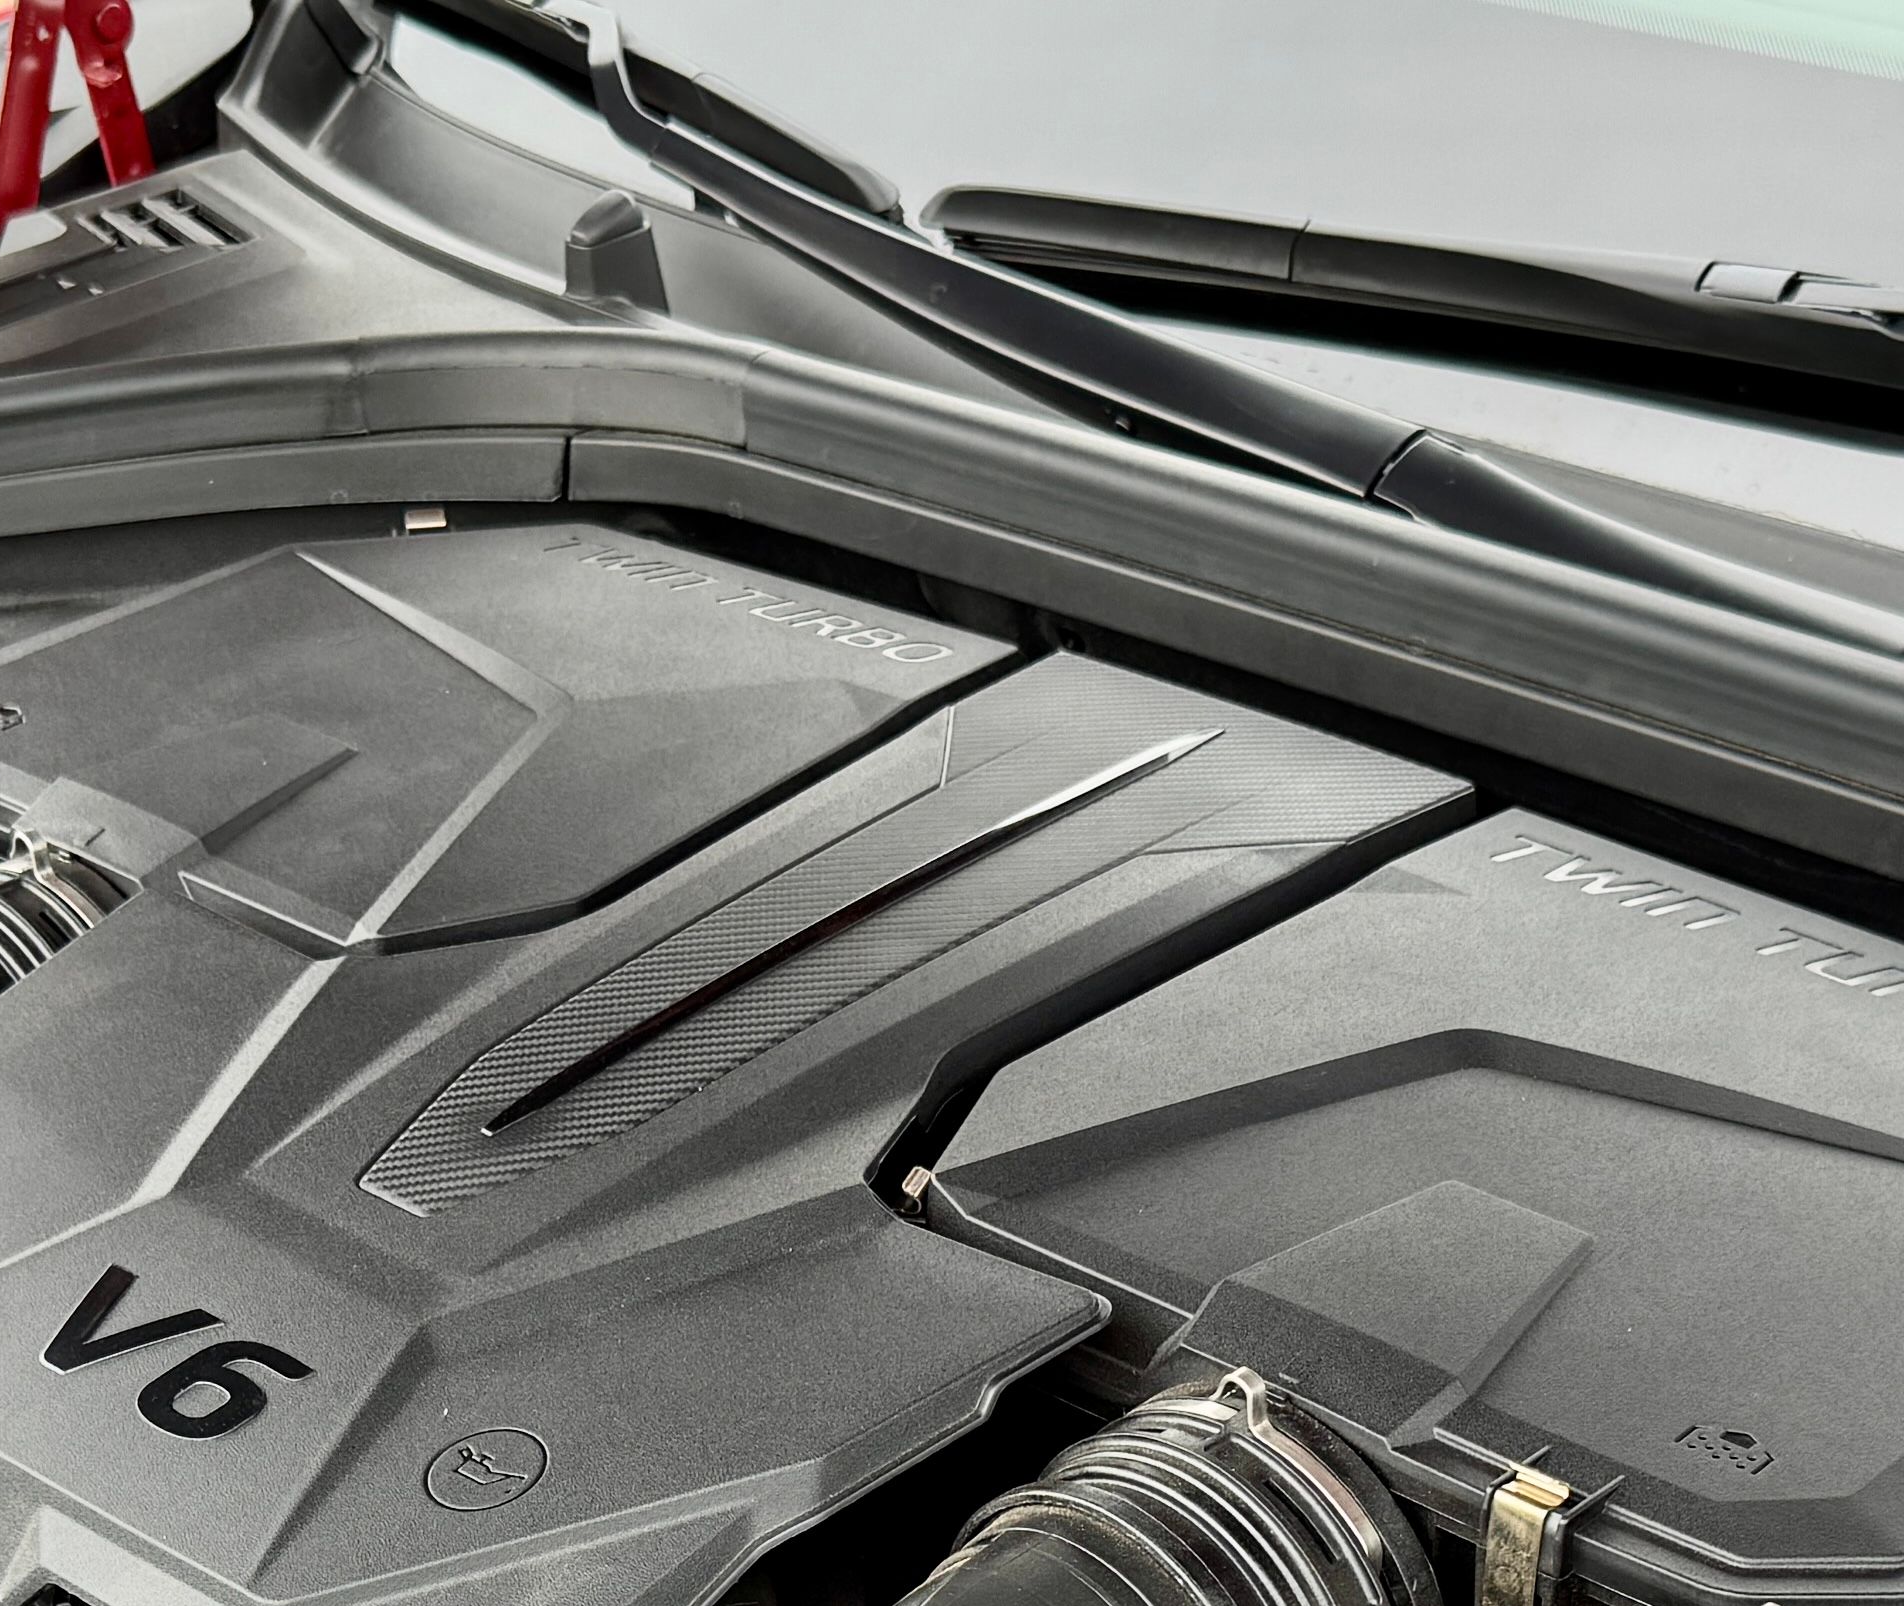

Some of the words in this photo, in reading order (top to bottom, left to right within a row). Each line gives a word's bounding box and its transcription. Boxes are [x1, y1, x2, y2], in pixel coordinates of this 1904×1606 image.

[716, 587, 954, 664] TURBO
[1490, 834, 1741, 931] TWIN
[39, 1263, 317, 1441] V6
